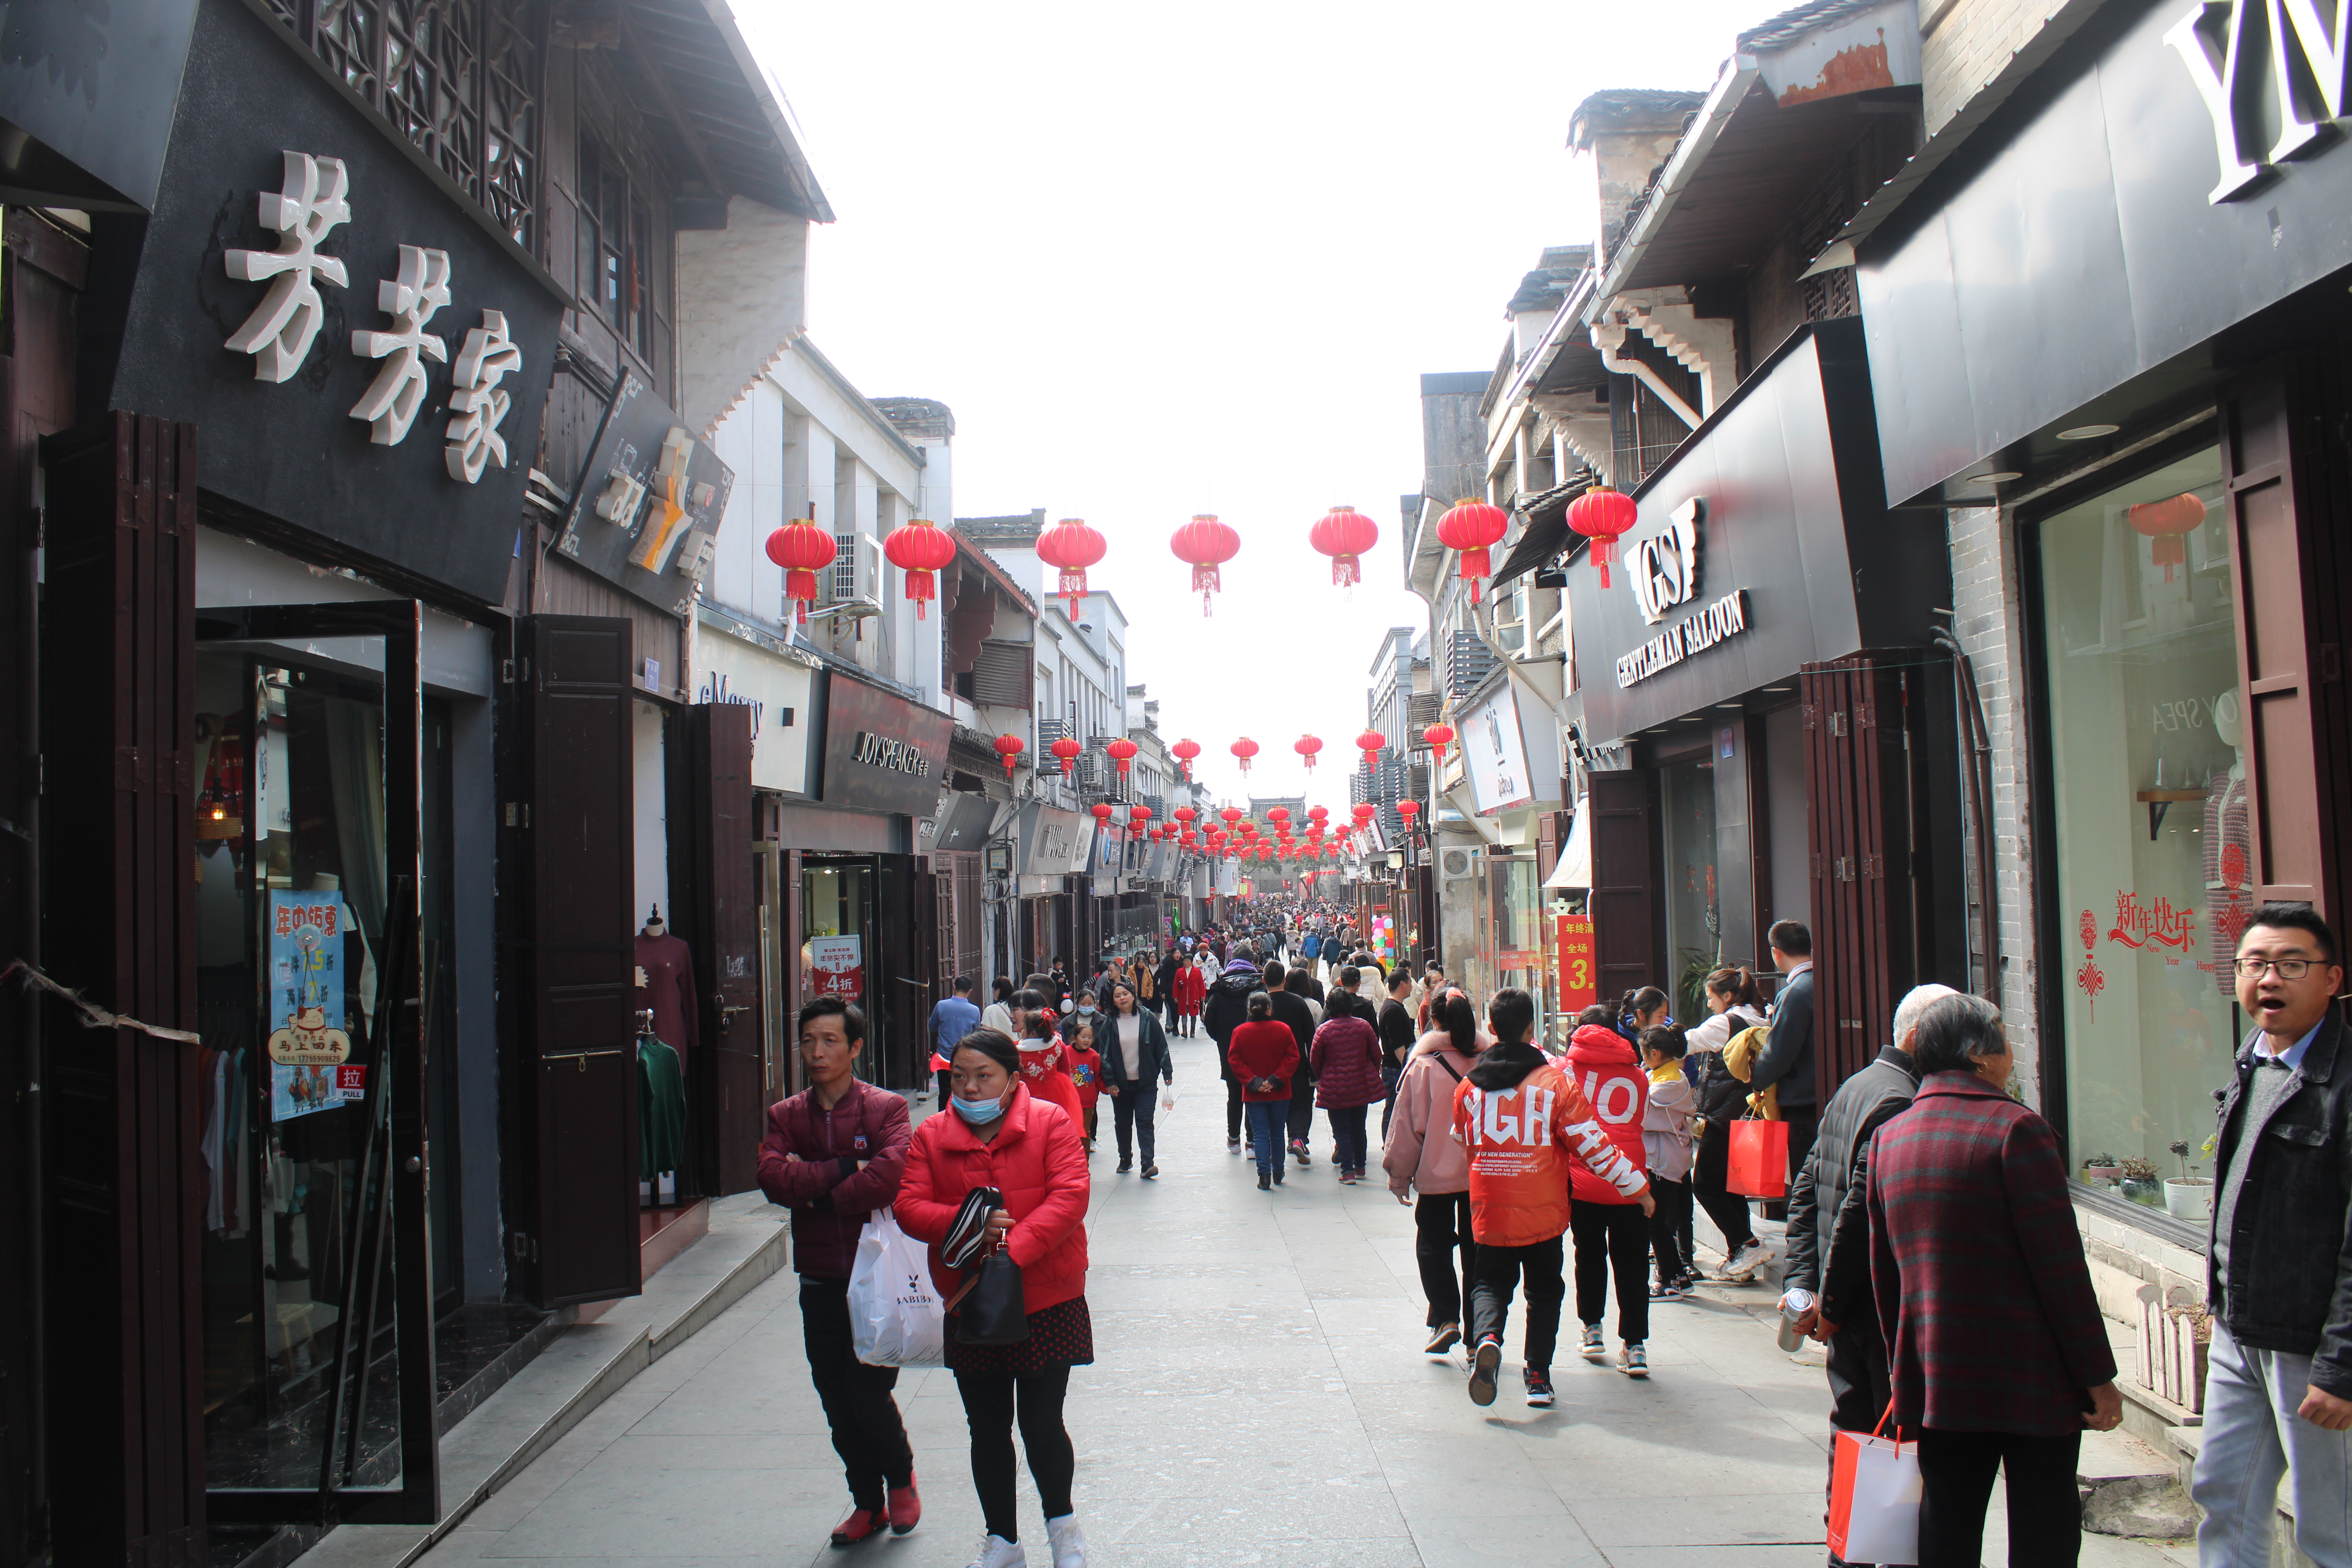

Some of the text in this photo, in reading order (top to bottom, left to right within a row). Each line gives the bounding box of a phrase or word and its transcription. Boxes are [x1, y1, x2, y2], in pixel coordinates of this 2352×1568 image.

[1616, 588, 1746, 689] GENTLEMAN SALOON
[858, 732, 882, 765] JOY
[879, 737, 920, 775] SPEAKER
[2115, 889, 2195, 953] 新年快乐
[1566, 923, 1594, 935] 年终清
[1567, 943, 1588, 954] 全场
[2146, 944, 2160, 953] New
[820, 954, 854, 962] 年货买不停
[2165, 956, 2217, 973] Year Happy
[279, 1040, 343, 1053] 马上回来
[343, 1069, 361, 1087] 拉
